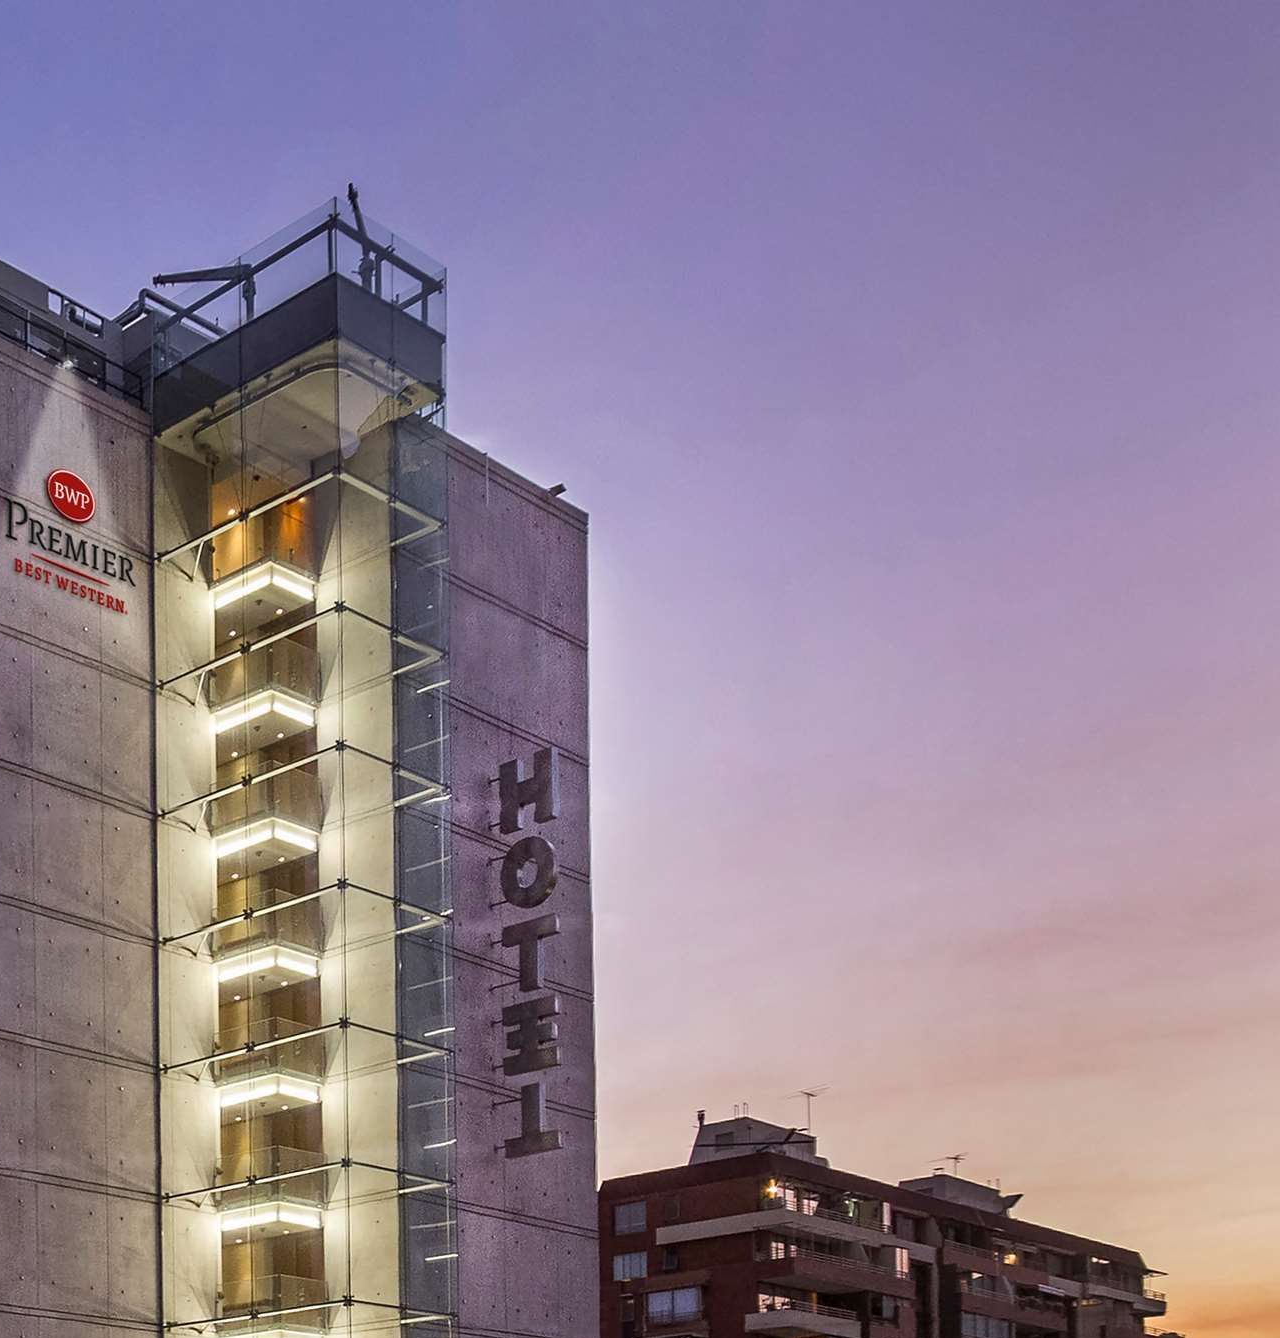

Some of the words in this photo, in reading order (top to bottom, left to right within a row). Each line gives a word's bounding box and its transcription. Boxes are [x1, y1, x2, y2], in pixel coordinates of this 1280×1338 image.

[53, 481, 90, 510] BWP
[5, 497, 136, 587] PREMIER
[14, 558, 52, 585] BEST
